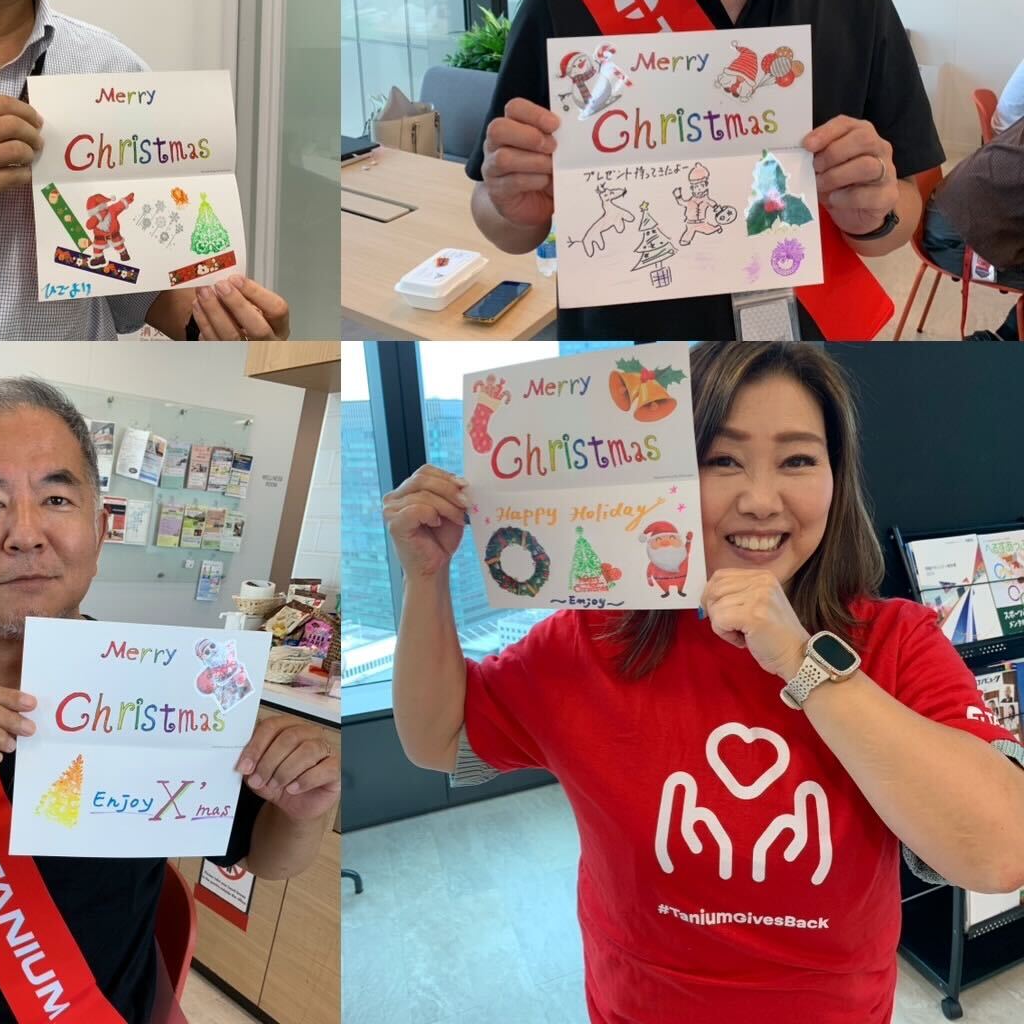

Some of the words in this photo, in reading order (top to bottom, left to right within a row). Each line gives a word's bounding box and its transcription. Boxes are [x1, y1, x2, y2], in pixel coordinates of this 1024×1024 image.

[630, 51, 709, 73] Merry
[95, 88, 156, 105] Merry
[591, 107, 778, 153] Christmas
[64, 133, 211, 172] Christmas
[523, 376, 591, 399] Merry
[491, 433, 661, 479] Christmas
[496, 504, 560, 528] Happy
[568, 497, 666, 531] Holiday
[100, 640, 177, 666] Merry
[55, 691, 226, 733] Christmas
[93, 791, 153, 812] Enjoy
[657, 903, 829, 929] #TaniumGivesBack
